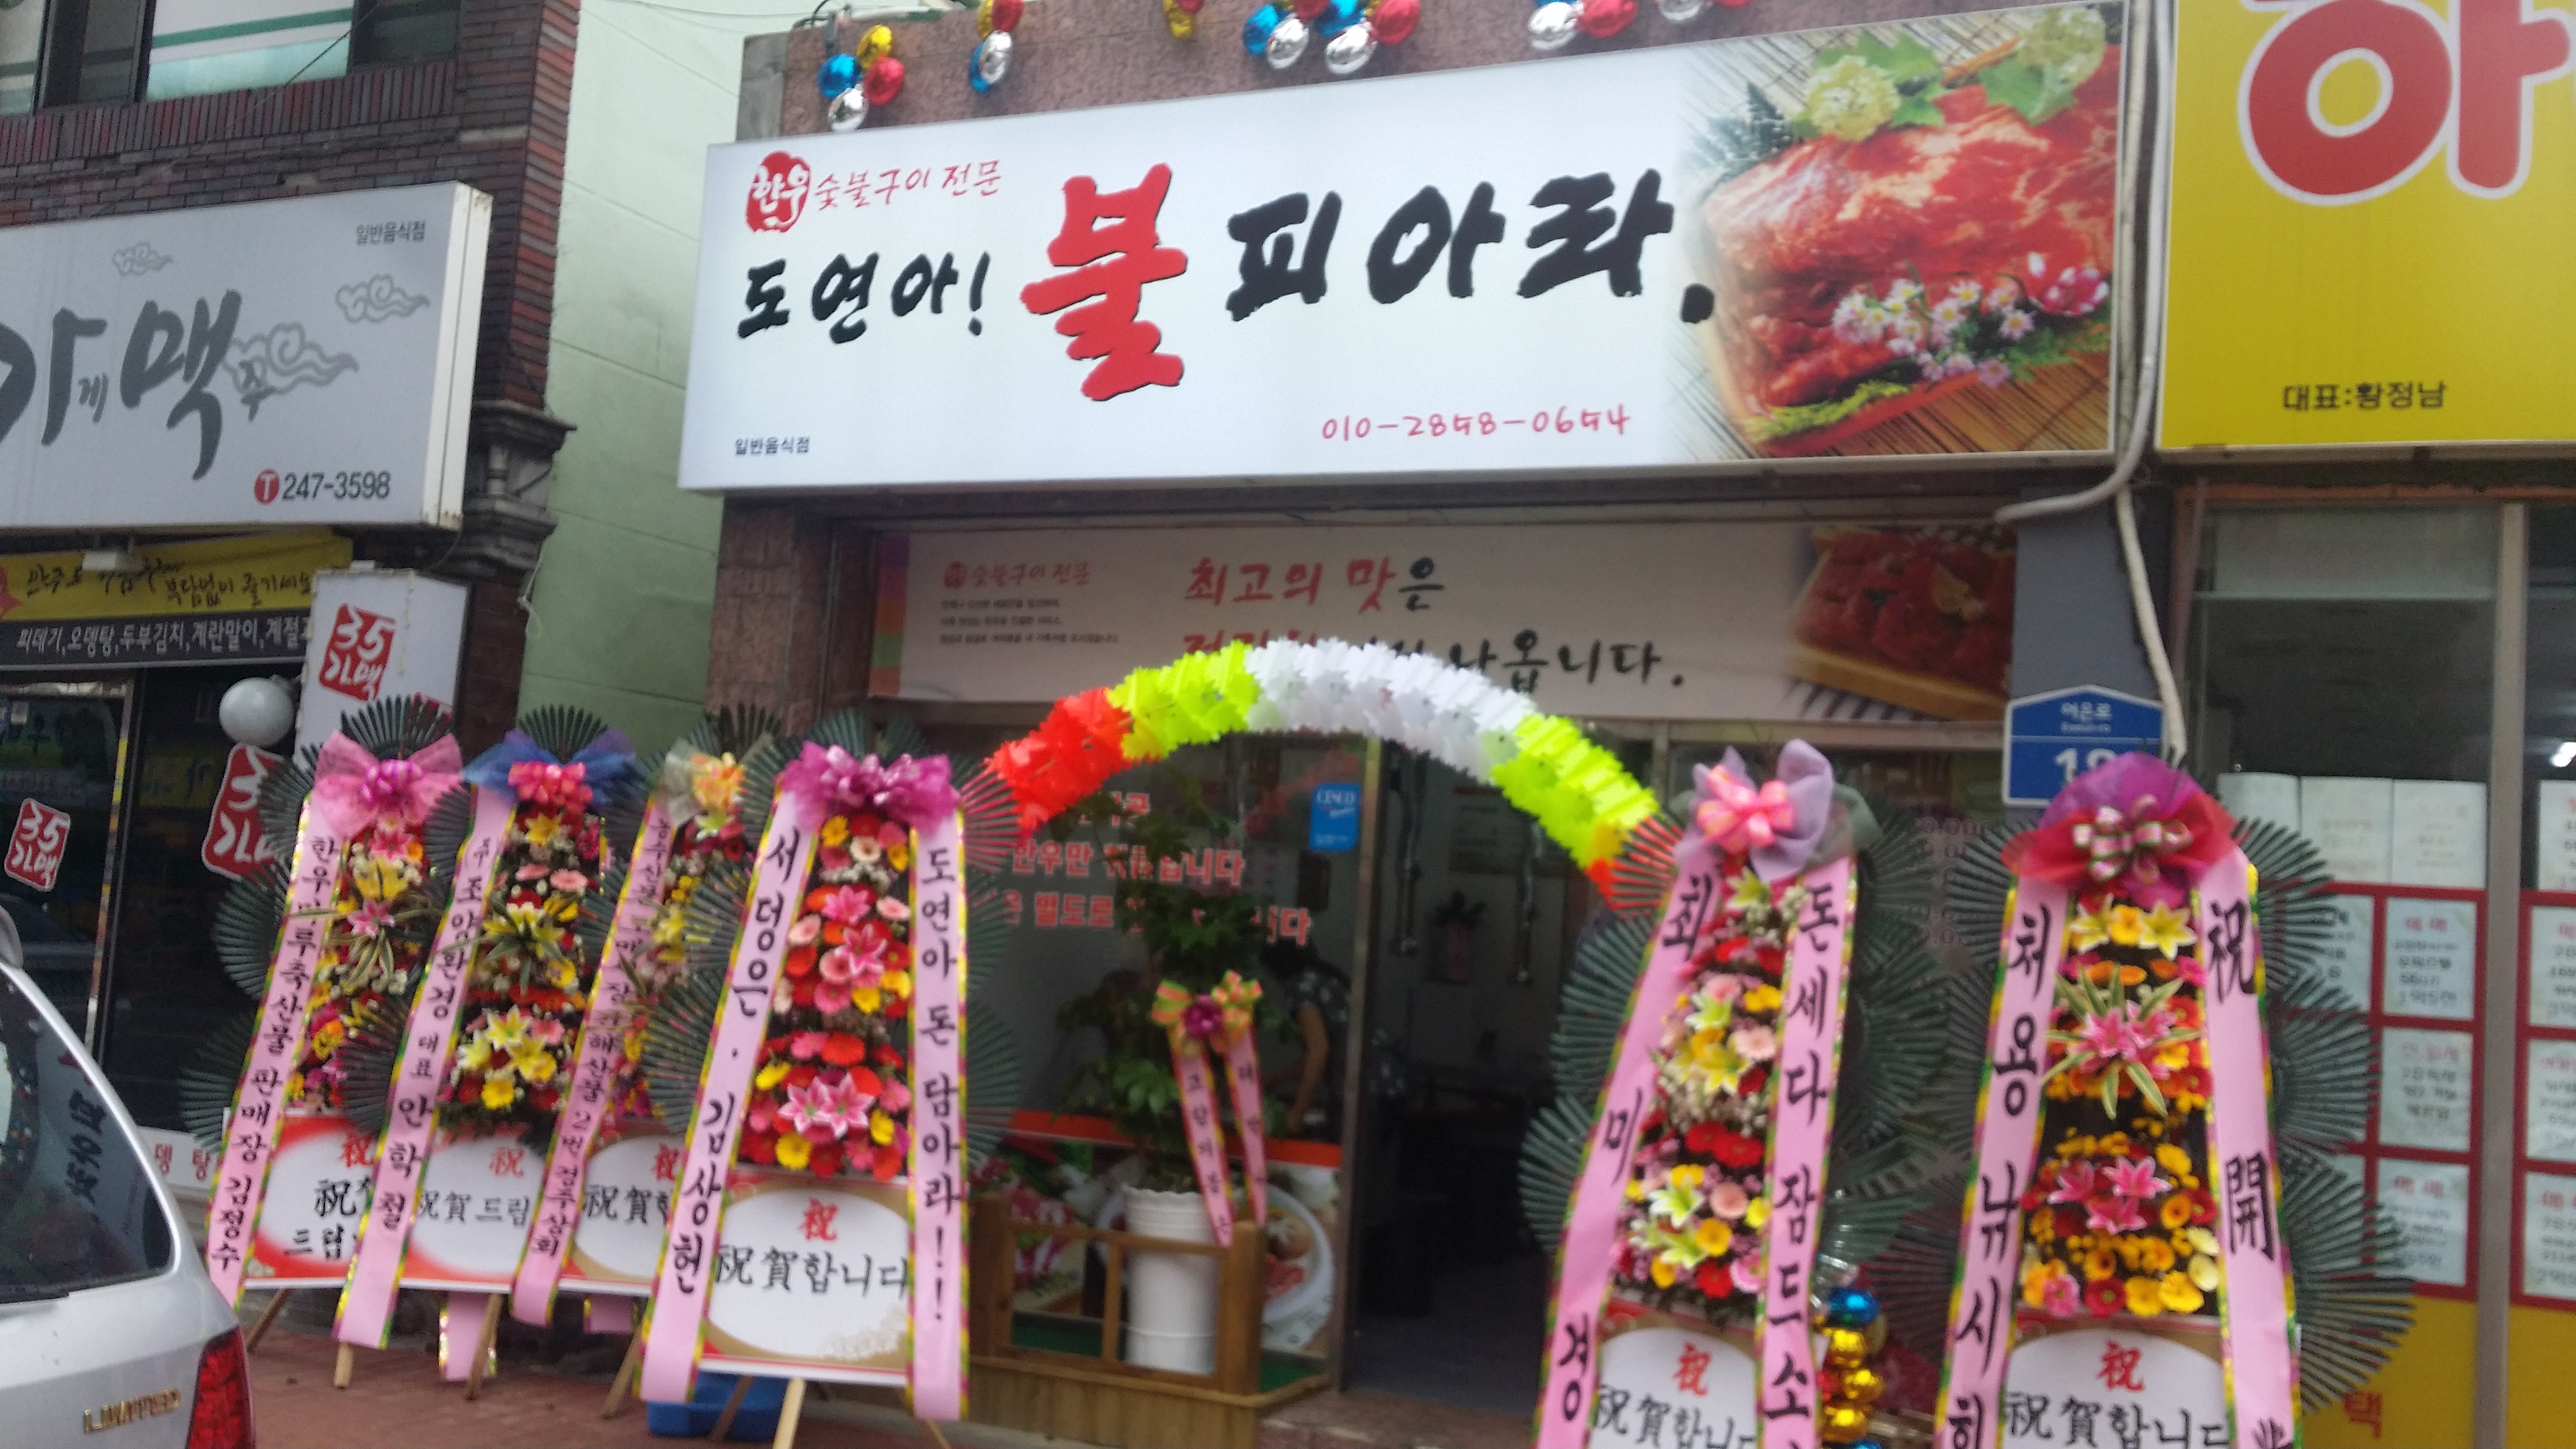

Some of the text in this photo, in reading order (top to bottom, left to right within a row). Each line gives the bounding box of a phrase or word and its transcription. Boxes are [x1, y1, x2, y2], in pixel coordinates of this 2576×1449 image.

[940, 160, 1002, 197] 전문
[356, 220, 426, 245] 일반음식점
[737, 162, 1715, 402] 도연아! 불 피아라.
[735, 436, 810, 456] 일반음식점
[282, 471, 391, 500] 247-3598
[1184, 555, 1445, 613] 최고의 맛은
[21, 799, 71, 853] 35
[1034, 892, 1114, 928] 별도로
[799, 1198, 839, 1242] 祝
[1674, 1341, 1712, 1396] 祝
[2095, 1339, 2145, 1393] 祝
